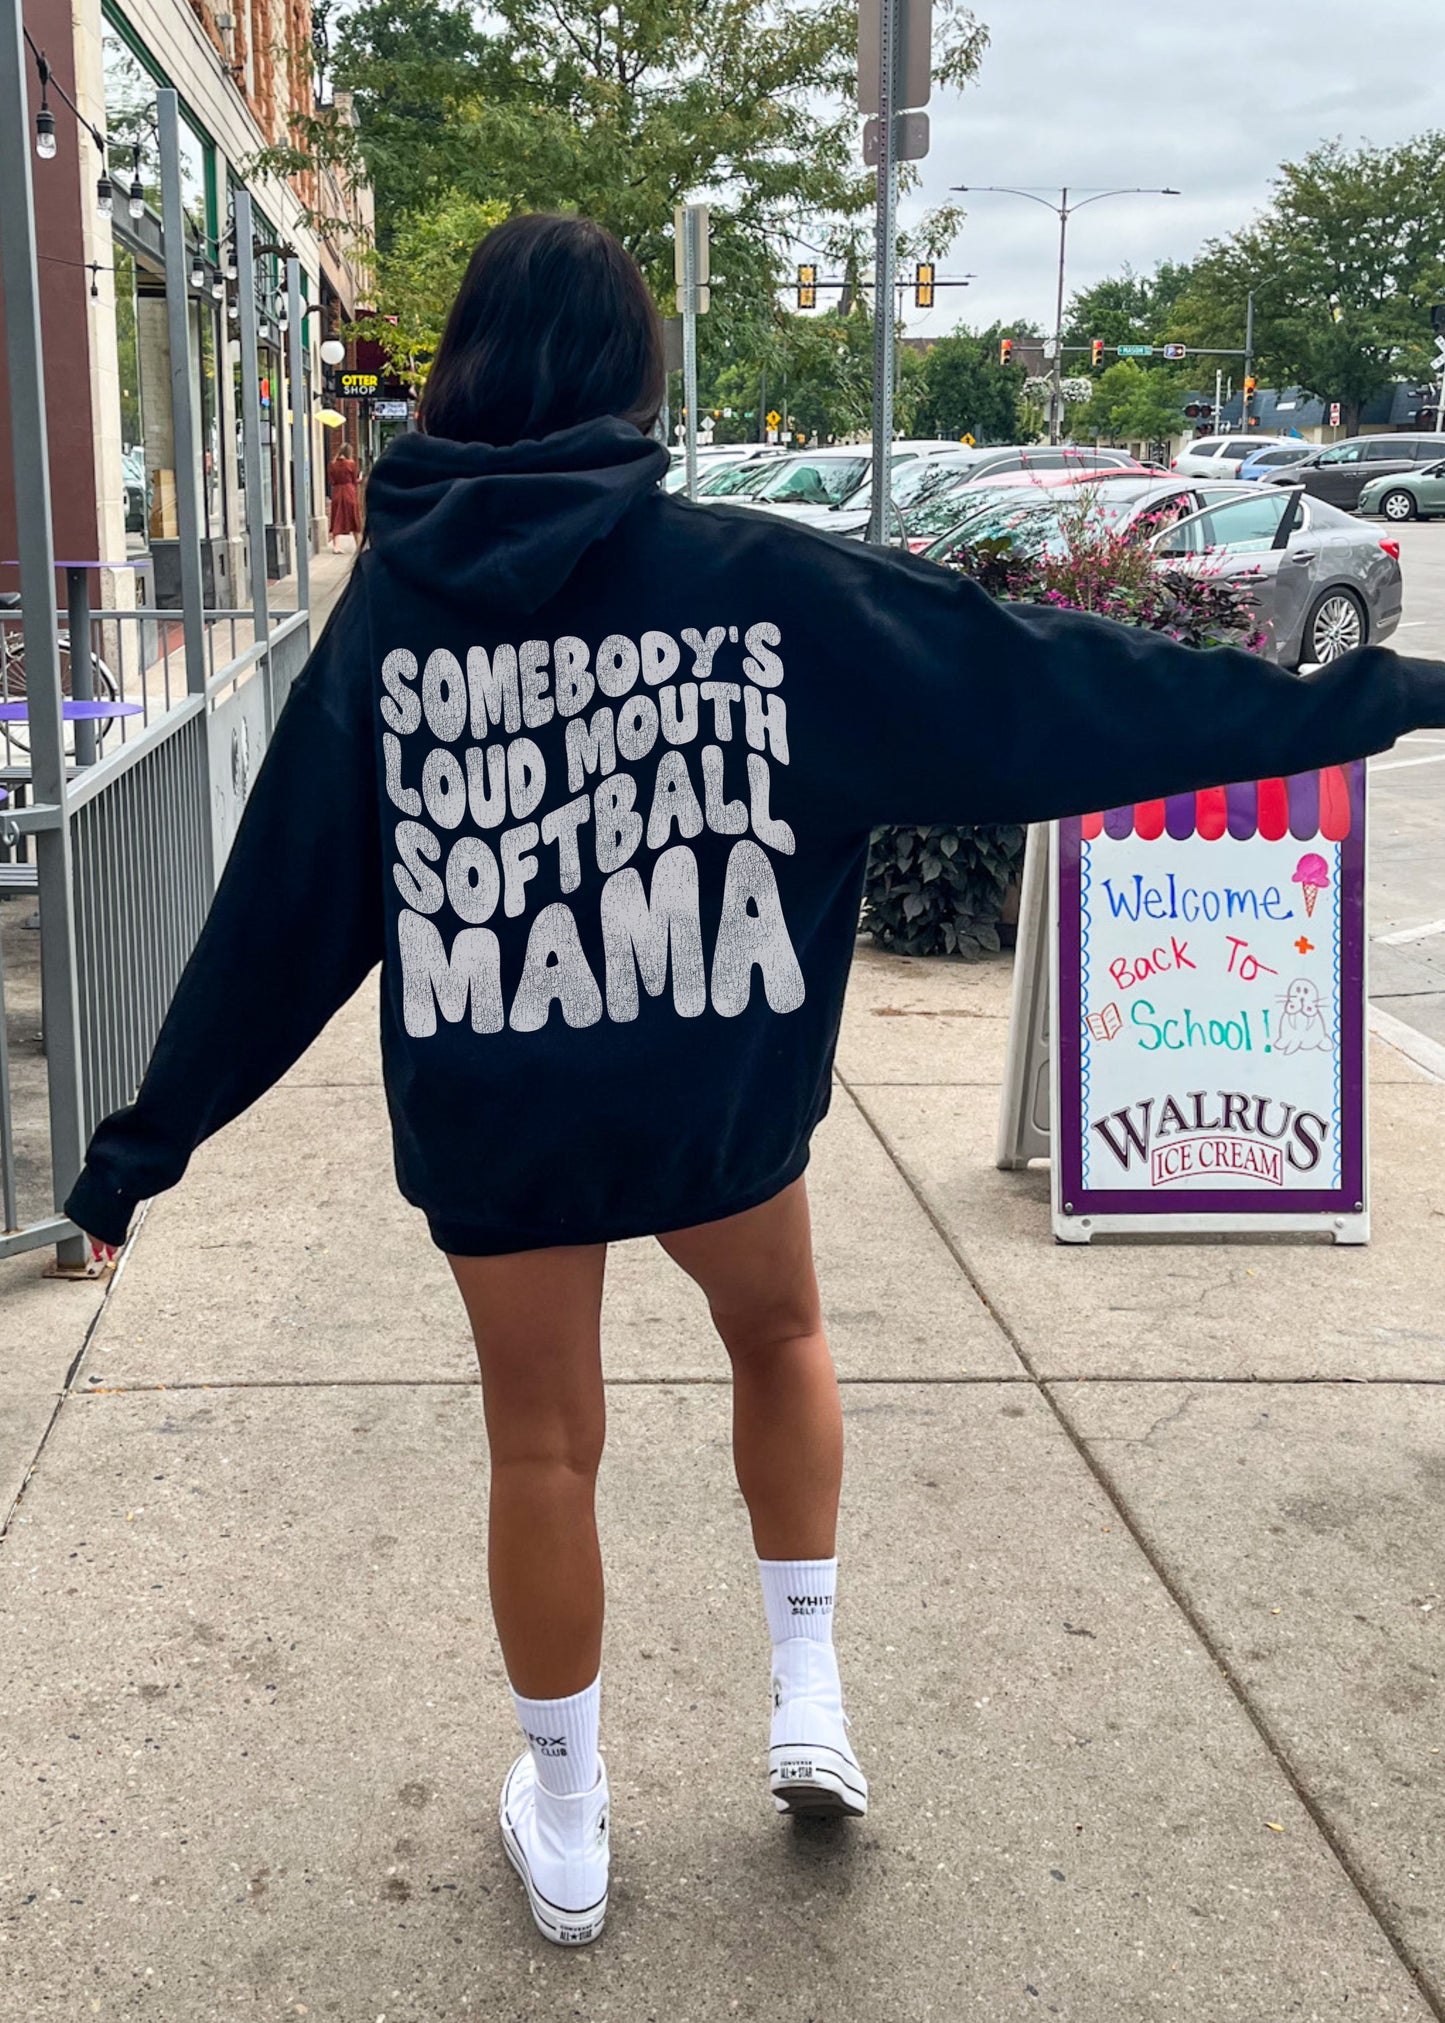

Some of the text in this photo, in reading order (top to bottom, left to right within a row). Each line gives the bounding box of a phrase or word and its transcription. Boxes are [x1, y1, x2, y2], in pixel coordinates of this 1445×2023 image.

[341, 374, 378, 386] OTTER
[344, 385, 376, 395] SHOP
[380, 622, 784, 742] SOMEBODY'S
[383, 682, 790, 829] LOUD MOUTH
[393, 745, 796, 924] SOFTBALL
[1101, 873, 1295, 922] Welcome
[398, 839, 806, 1038] MAMA
[1091, 1090, 1330, 1171] WALRUS
[1157, 1141, 1280, 1180] ICE CREAM
[541, 1748, 567, 1757] CLUB
[781, 1766, 812, 1778] ALL STAR
[560, 1931, 569, 1941] ALL
